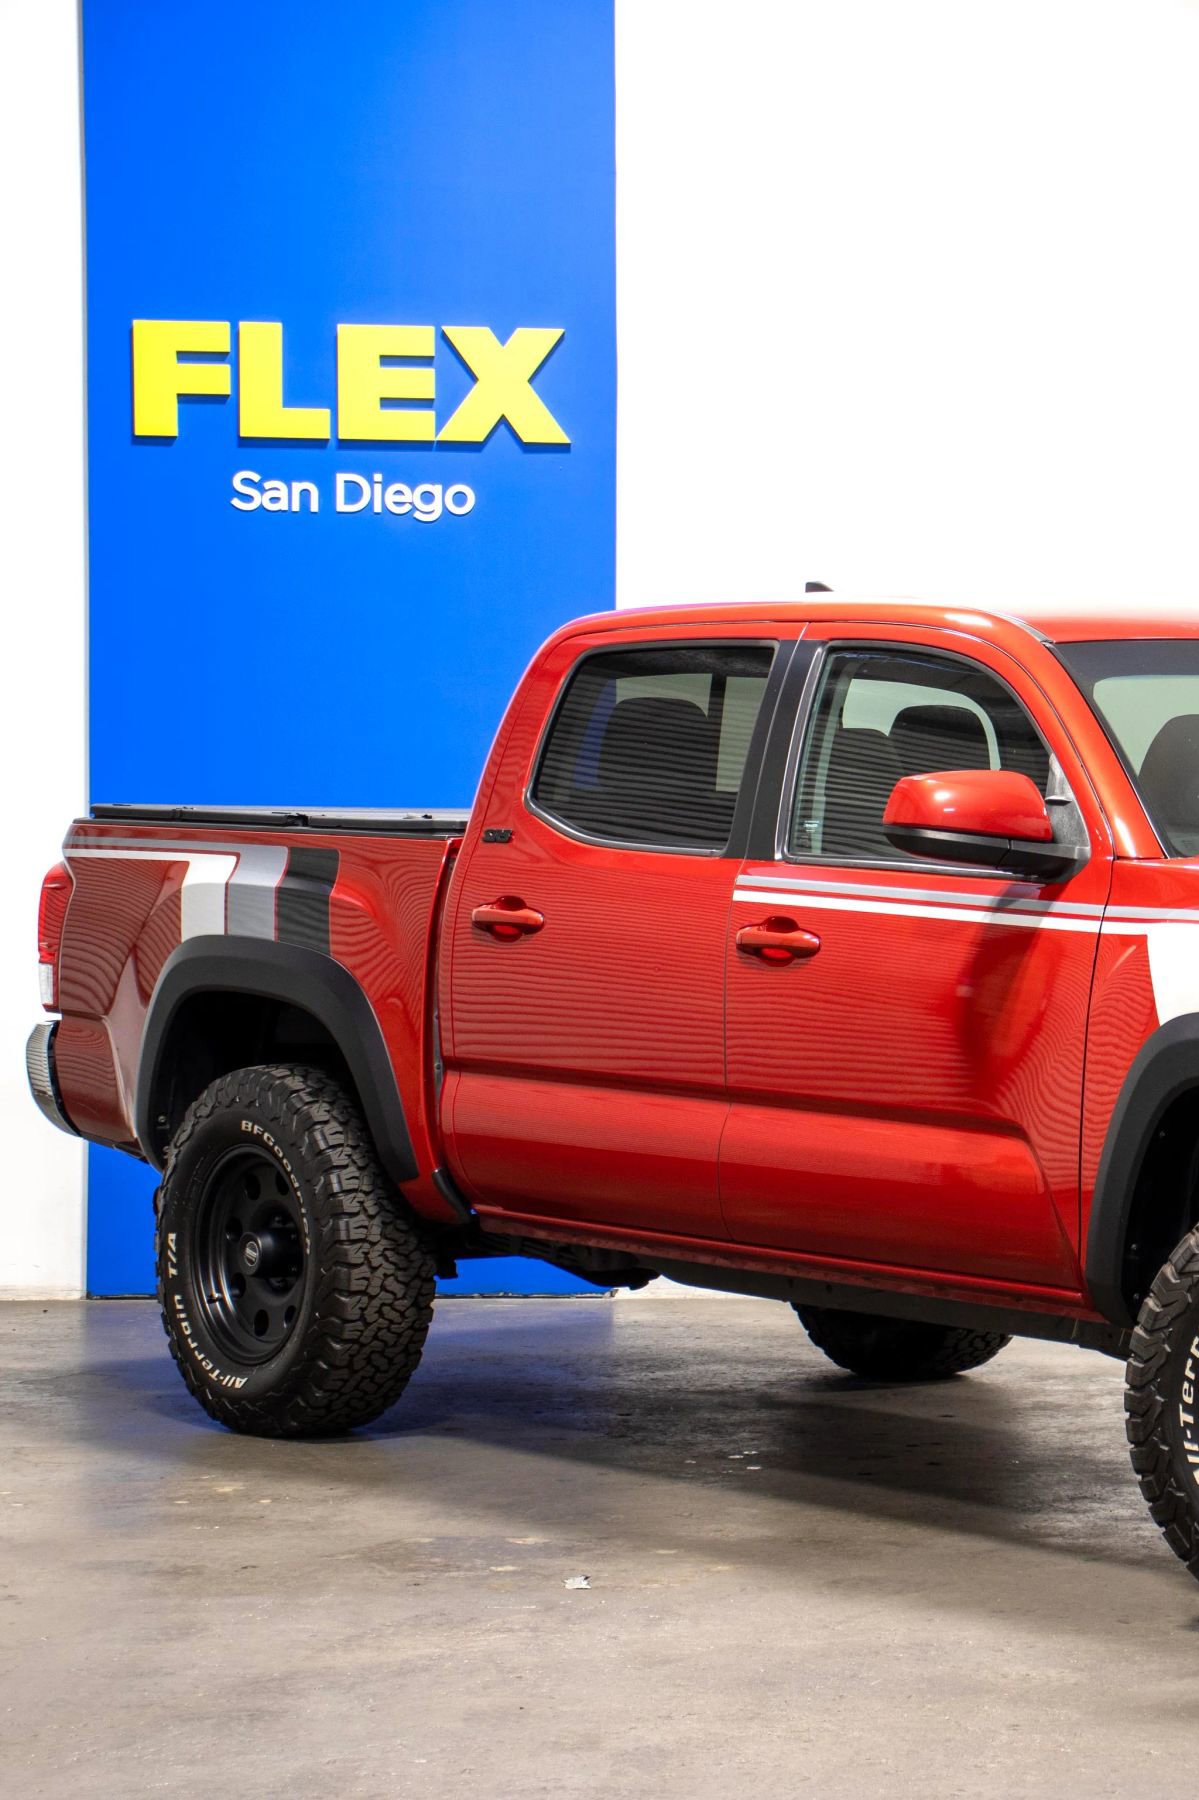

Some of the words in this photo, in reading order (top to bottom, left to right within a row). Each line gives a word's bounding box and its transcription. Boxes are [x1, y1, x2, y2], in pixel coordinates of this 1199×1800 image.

[132, 319, 572, 445] FLEX
[230, 470, 319, 514] San
[335, 472, 476, 522] Diego
